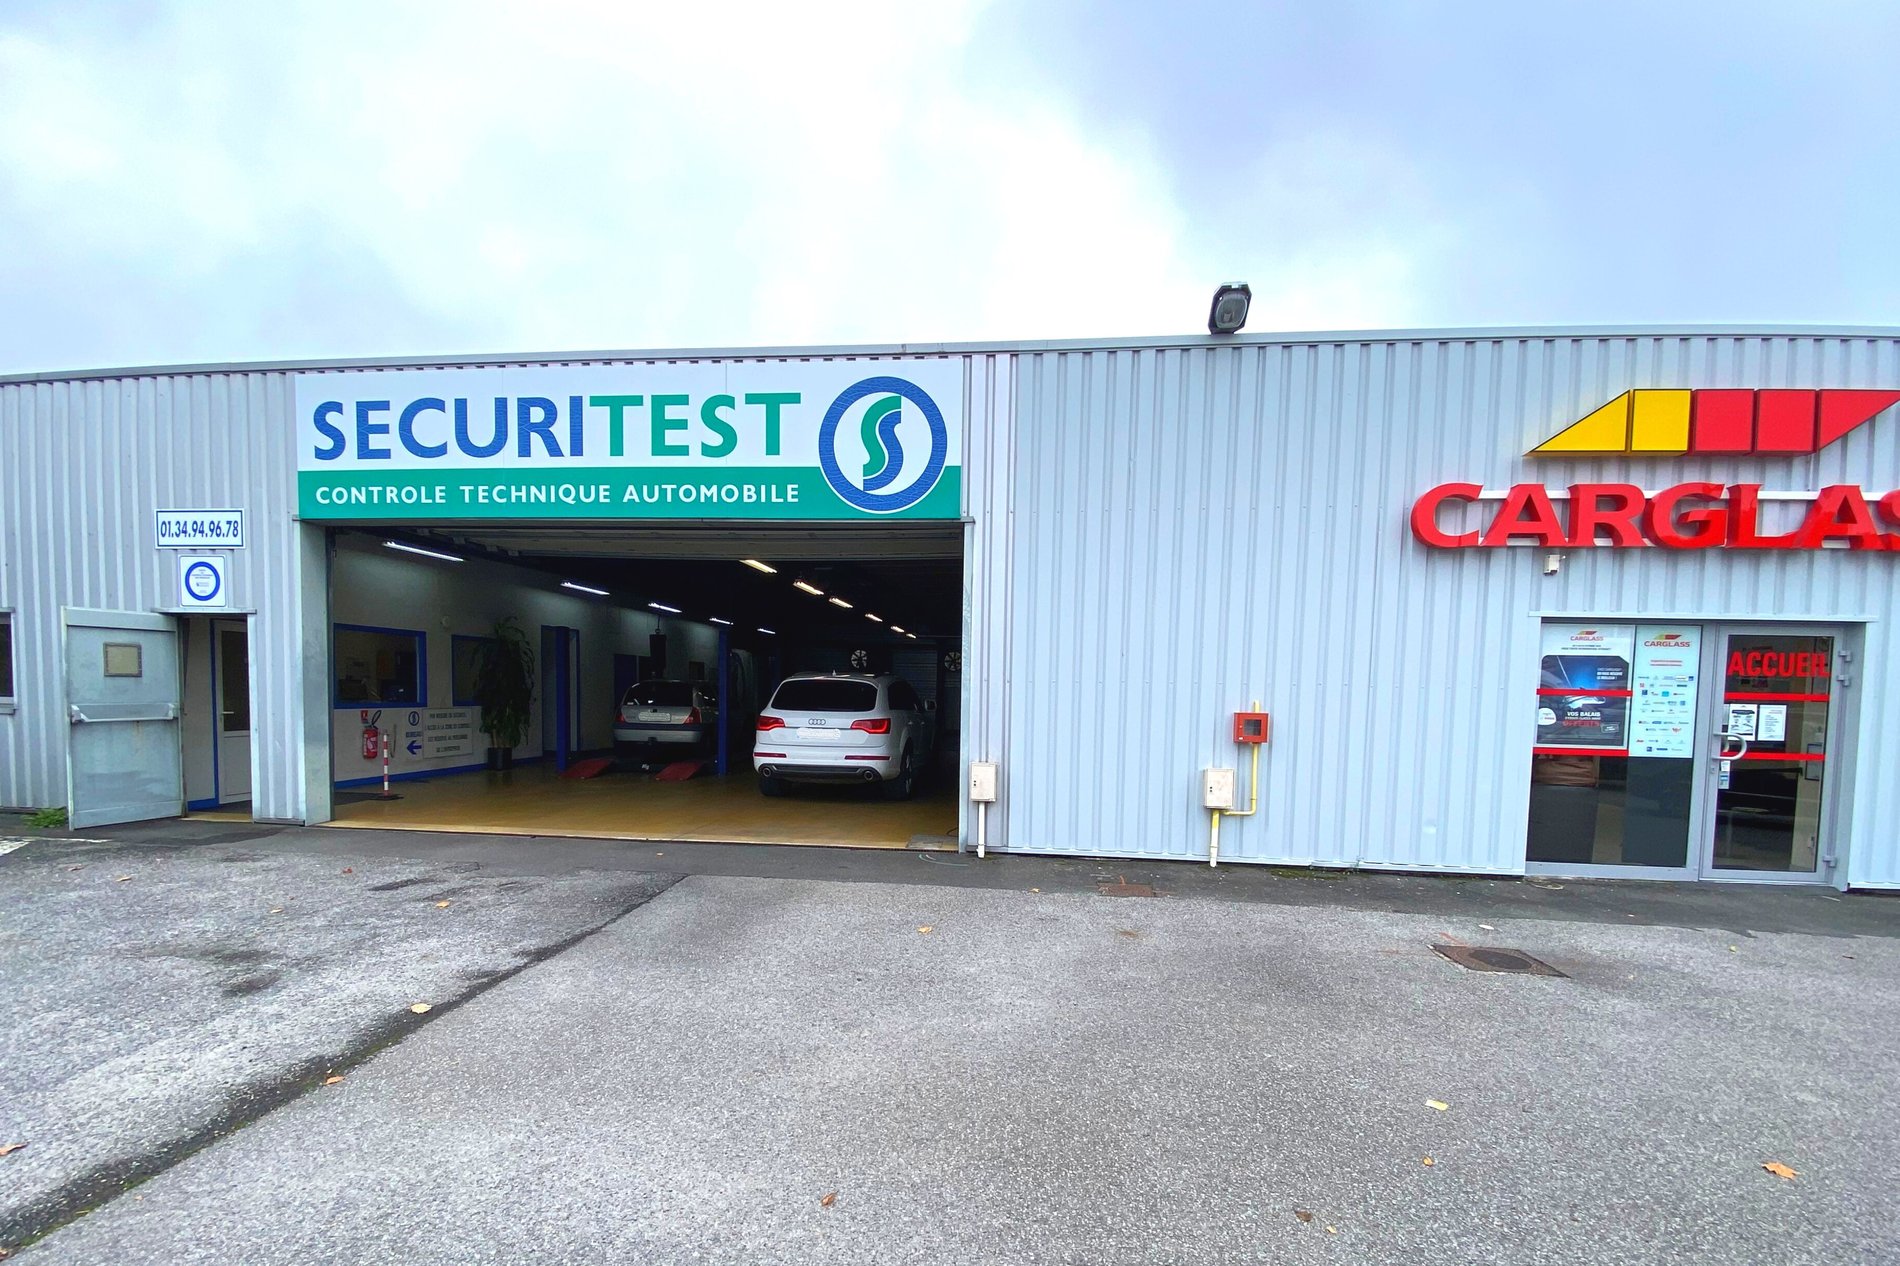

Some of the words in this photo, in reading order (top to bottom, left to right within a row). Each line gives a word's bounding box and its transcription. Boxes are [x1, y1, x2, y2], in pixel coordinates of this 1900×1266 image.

[313, 392, 801, 460] SECURITEST
[315, 484, 446, 505] CONTROLE
[459, 484, 611, 505] TECHNIQUE
[622, 482, 799, 504] AUTOMOBILE
[160, 520, 239, 538] 01.34.94.96.78
[1727, 651, 1830, 678] ACCUEIL
